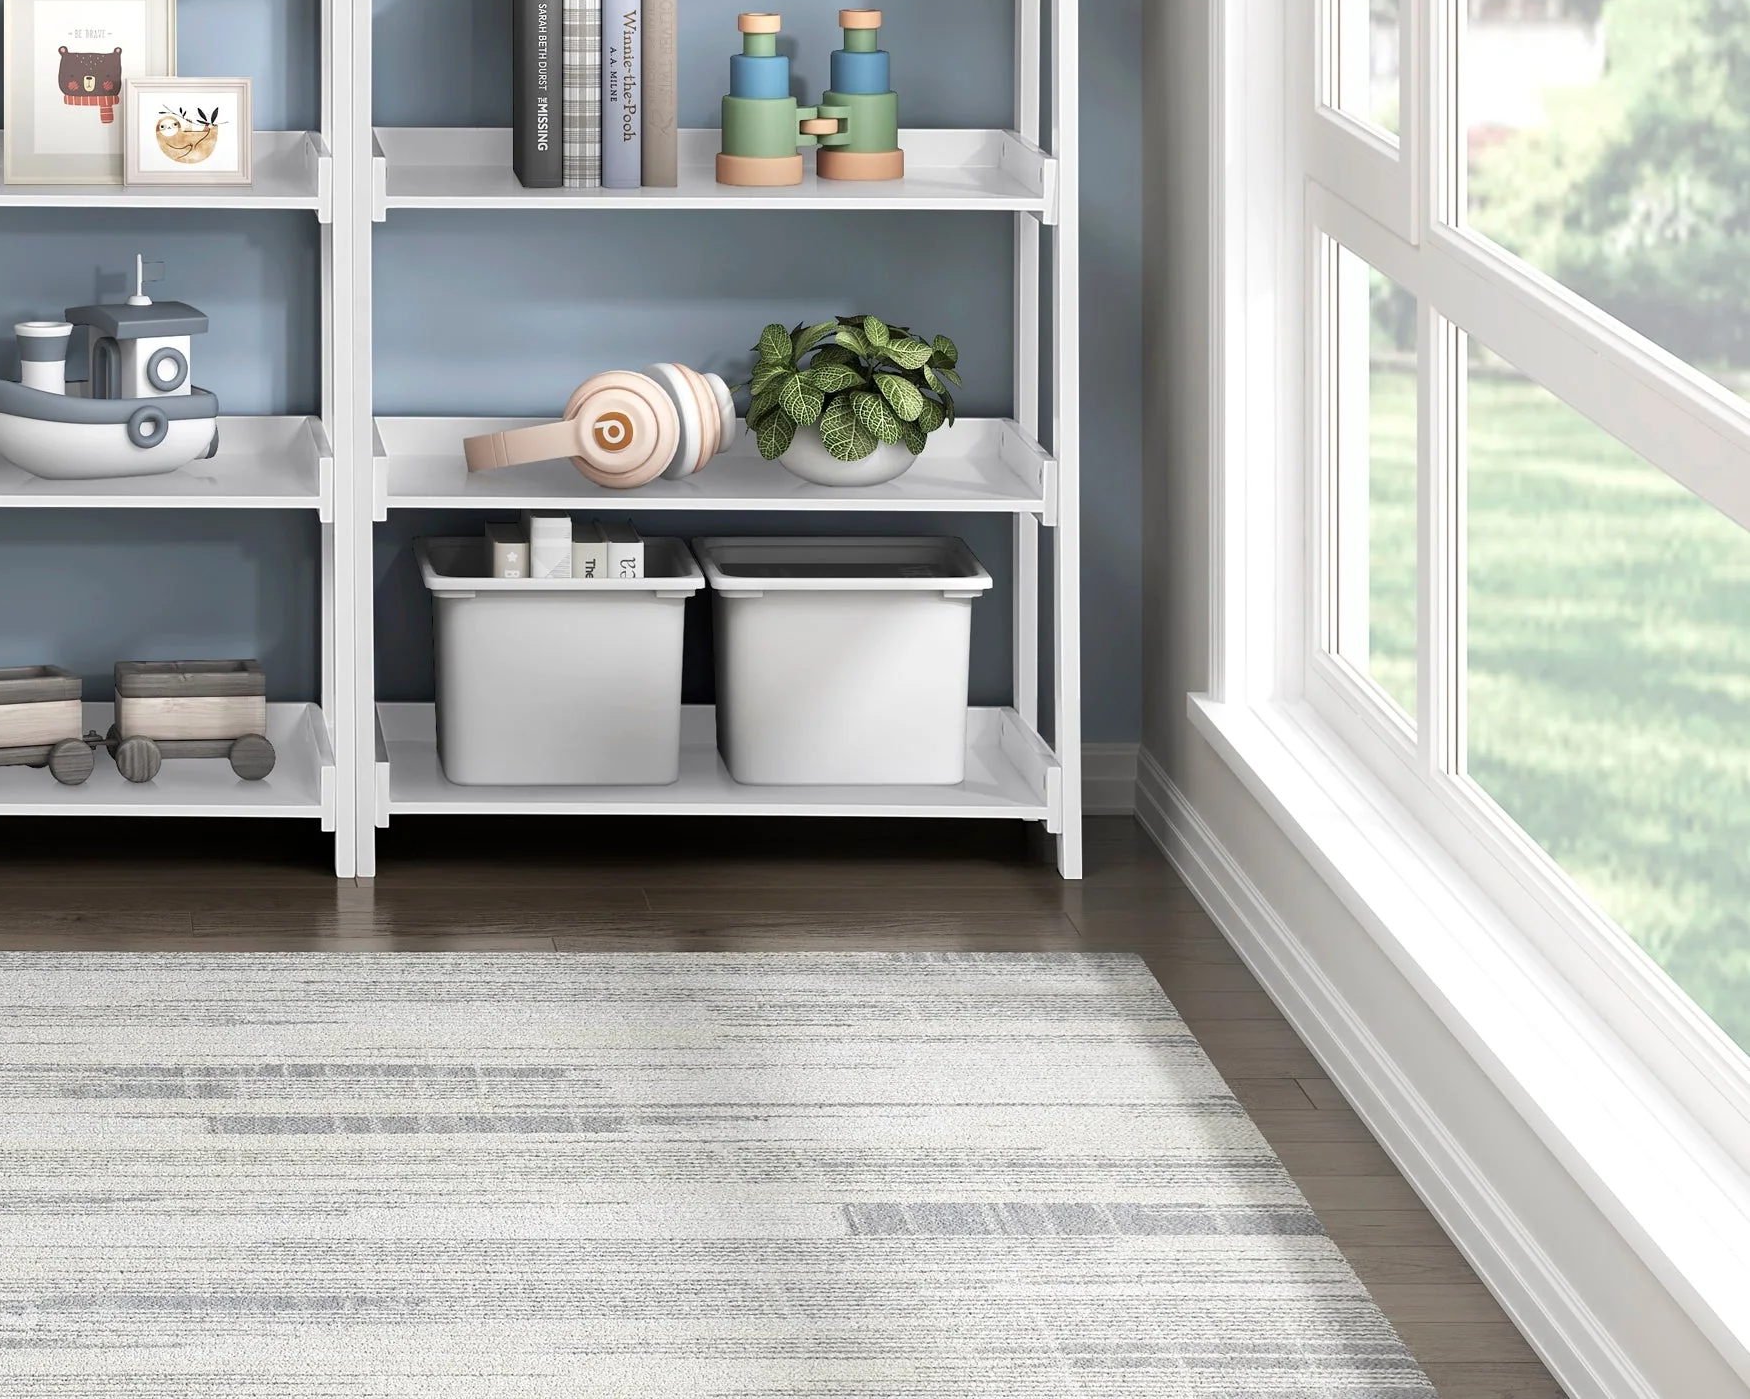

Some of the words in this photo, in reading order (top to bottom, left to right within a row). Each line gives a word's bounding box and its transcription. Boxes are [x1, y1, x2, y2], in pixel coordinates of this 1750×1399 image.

[538, 3, 548, 33] SARAH
[538, 35, 548, 60] BETH
[538, 61, 548, 91] DURST
[609, 71, 618, 102] MILNE
[623, 9, 637, 142] Winnie-the-Pooh
[537, 103, 548, 151] MISSING
[585, 558, 596, 578] The
